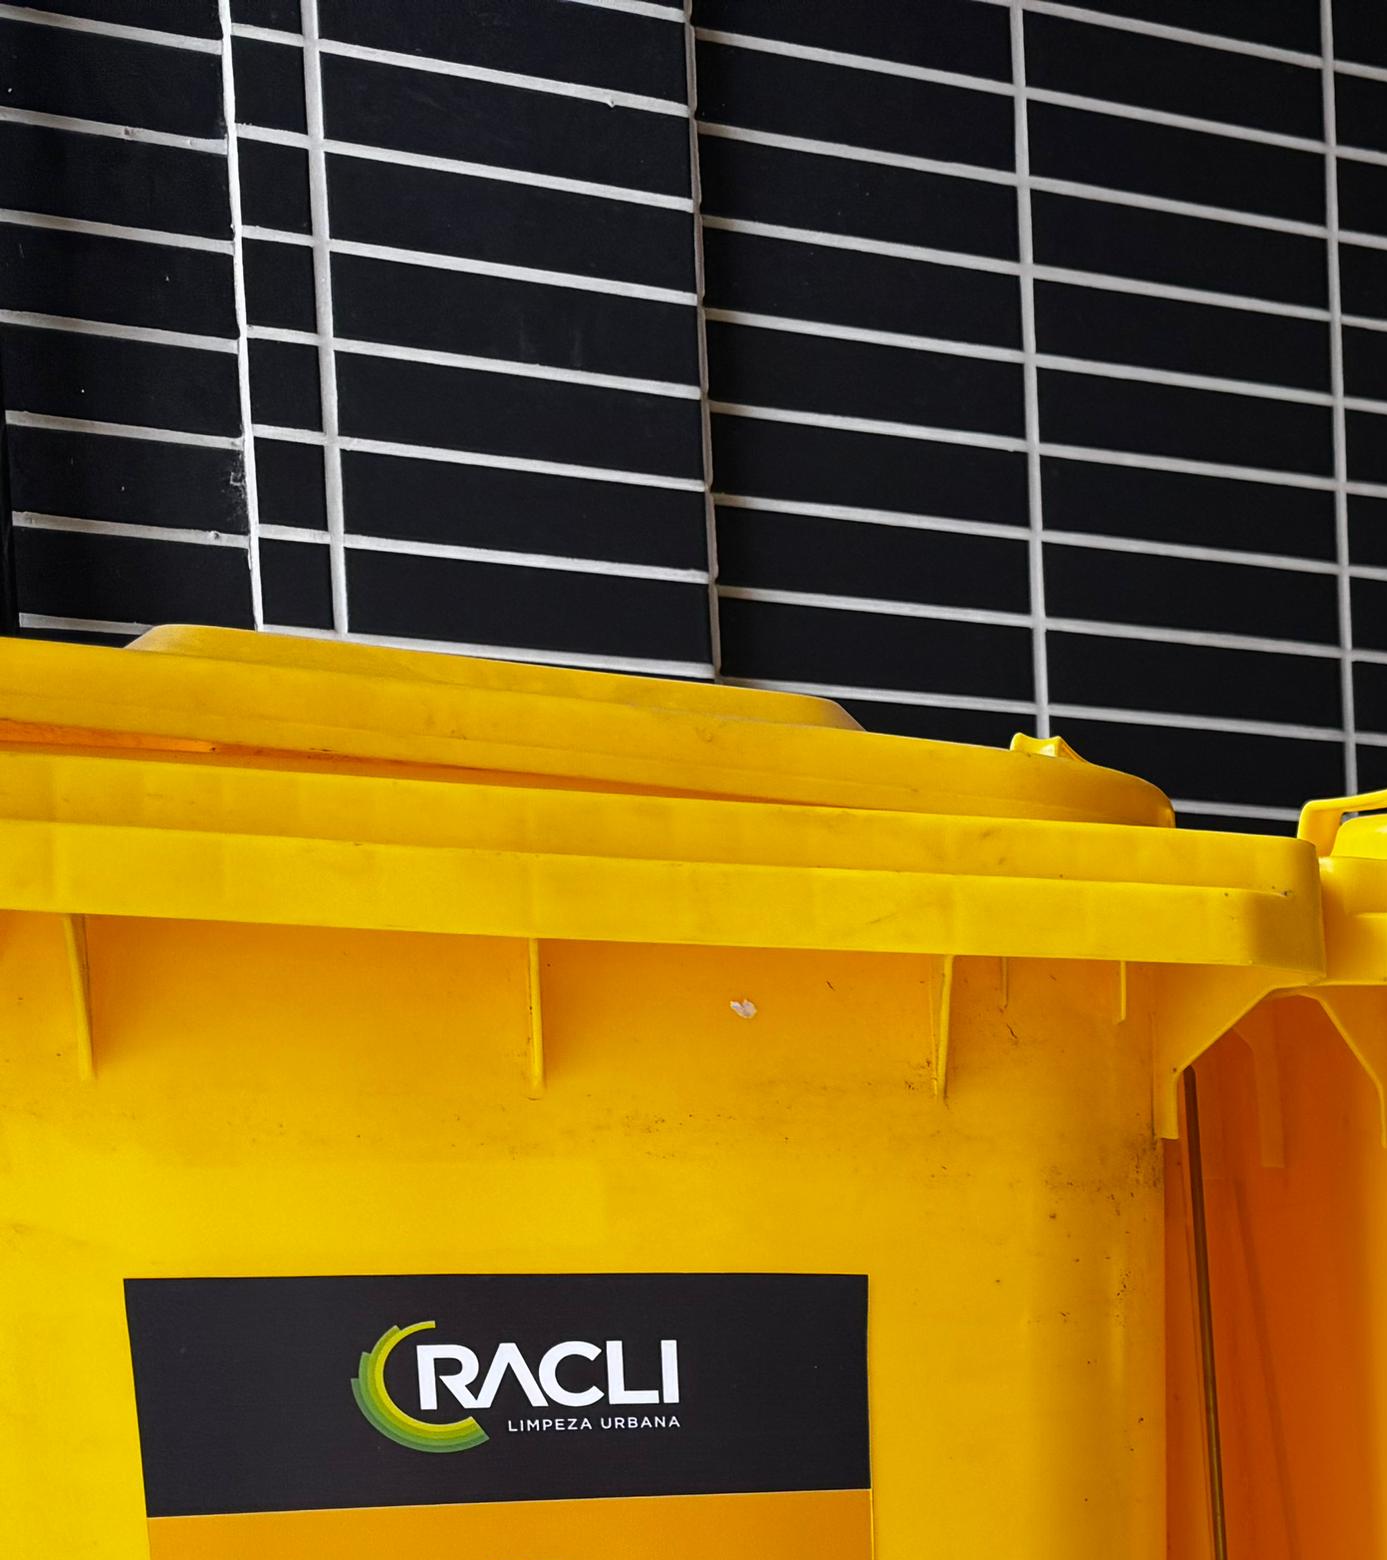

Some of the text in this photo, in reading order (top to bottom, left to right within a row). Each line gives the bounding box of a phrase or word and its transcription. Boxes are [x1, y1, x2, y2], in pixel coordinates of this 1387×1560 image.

[417, 1339, 680, 1411] RACLI
[508, 1415, 681, 1432] LIMPEZA URBANA
